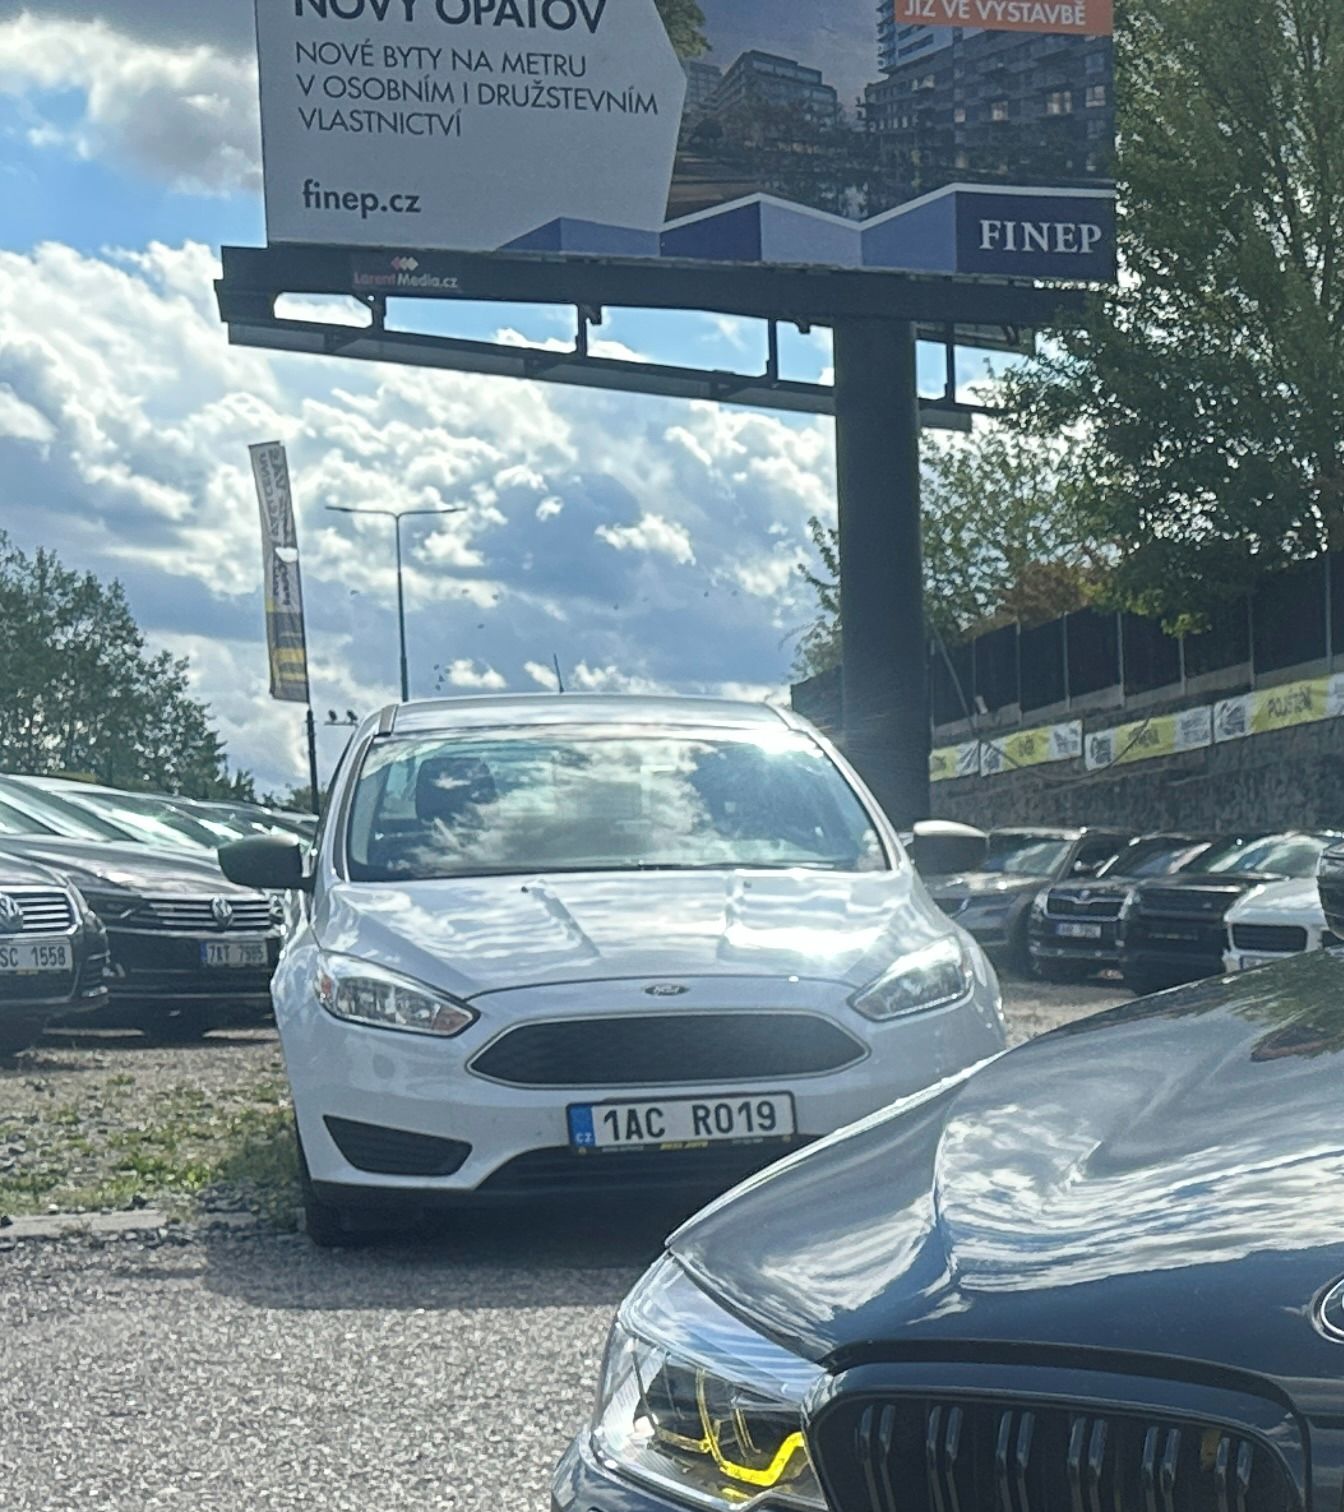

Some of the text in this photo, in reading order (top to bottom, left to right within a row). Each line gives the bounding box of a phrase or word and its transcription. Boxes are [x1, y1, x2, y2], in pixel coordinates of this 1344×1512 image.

[942, 0, 970, 19] VE
[296, 38, 586, 78] NOVÉ BYTY NA METRU
[296, 74, 658, 115] V OSOBNÍM I DRUŽSTEVNÍM
[298, 107, 461, 137] VLASTNICTVÍ
[303, 179, 421, 218] finep.cz
[979, 219, 1102, 254] FINEP
[0, 945, 66, 968] SC 1558
[575, 1132, 592, 1144] CZ
[603, 1107, 666, 1142] 1AC
